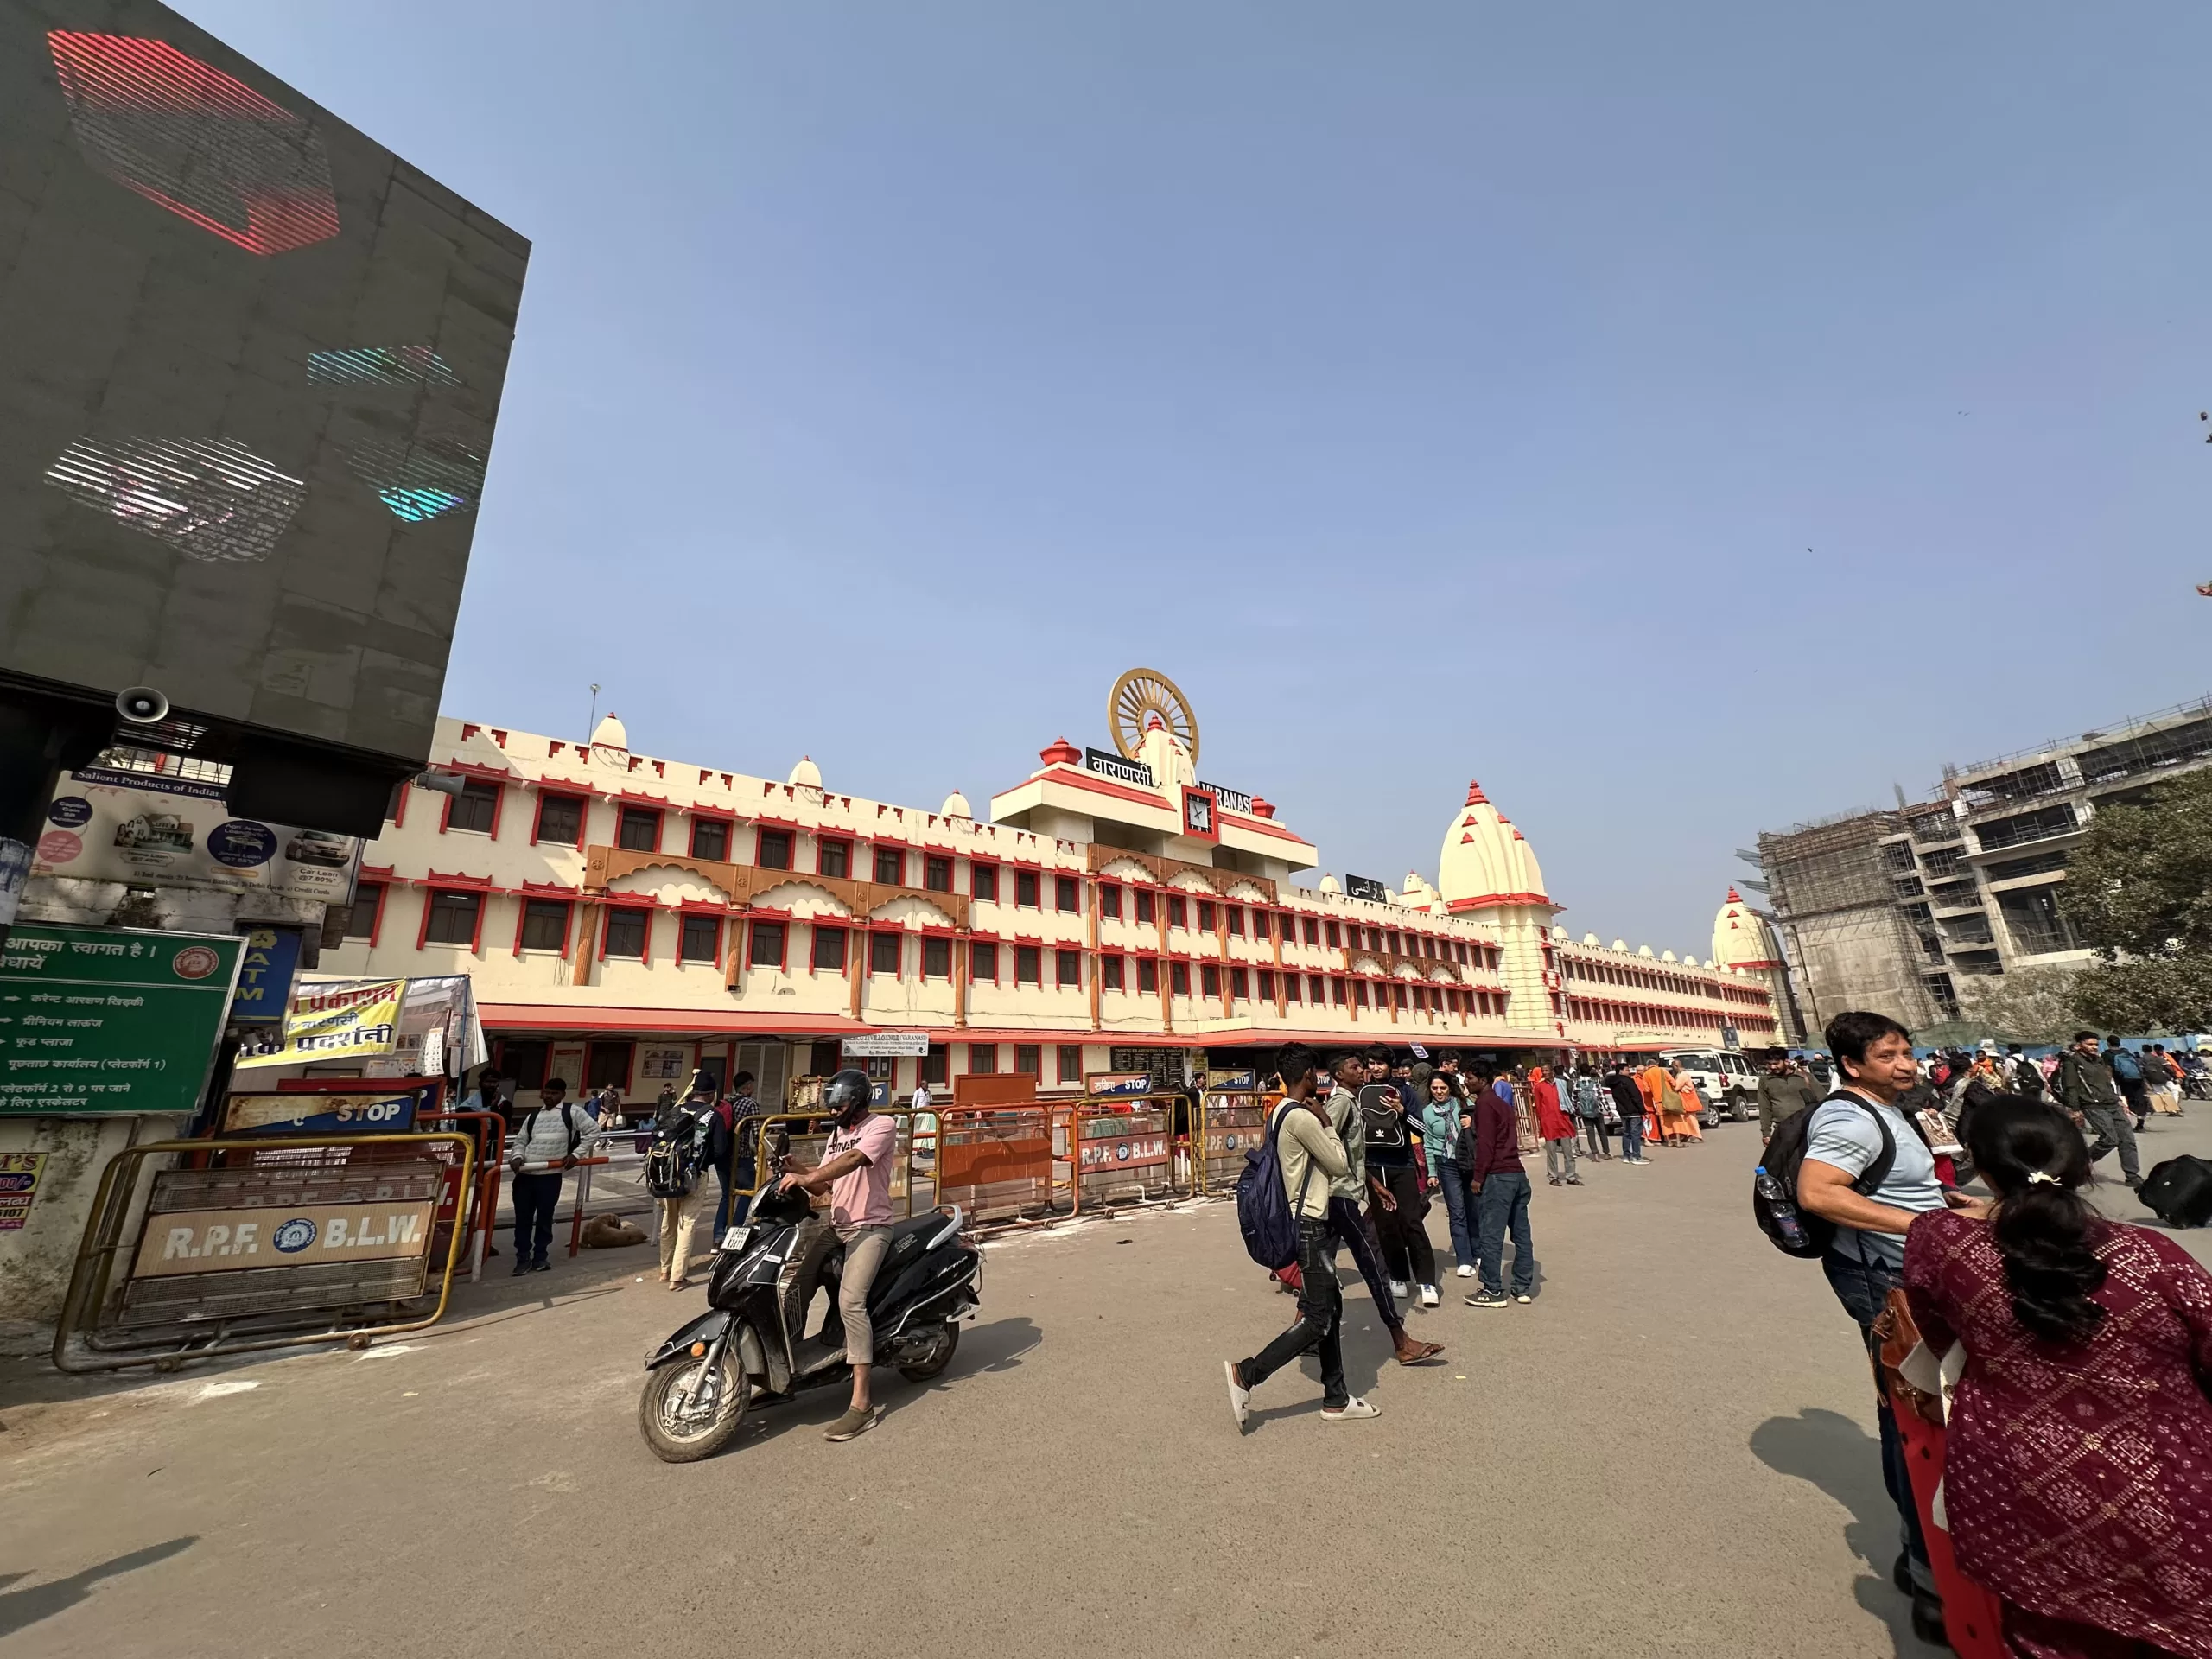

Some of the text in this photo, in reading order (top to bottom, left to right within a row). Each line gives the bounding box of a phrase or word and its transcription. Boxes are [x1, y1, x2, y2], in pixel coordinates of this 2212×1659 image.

[1092, 756, 1150, 785] वाराणसी
[78, 771, 118, 783] Salient
[121, 776, 170, 791] Products
[173, 784, 186, 792] of
[5, 938, 65, 952] आपका
[71, 941, 125, 956] स्वागत
[130, 942, 144, 957] है
[155, 1059, 167, 1071] 1)
[1125, 1079, 1147, 1090] STOP
[1234, 1076, 1249, 1085] STOP
[1316, 1076, 1331, 1084] STOP
[50, 1084, 59, 1093] 2
[62, 1083, 74, 1093] से
[78, 1084, 86, 1093] 9
[91, 1084, 106, 1093] पर
[108, 1083, 131, 1093] जाने
[10, 1096, 35, 1107] लिए
[337, 1103, 401, 1122] STOP
[1081, 1140, 1166, 1165] R.P.F. B.L.W.
[163, 1224, 258, 1260] R.P.F.
[323, 1215, 422, 1248] B.L.W.
